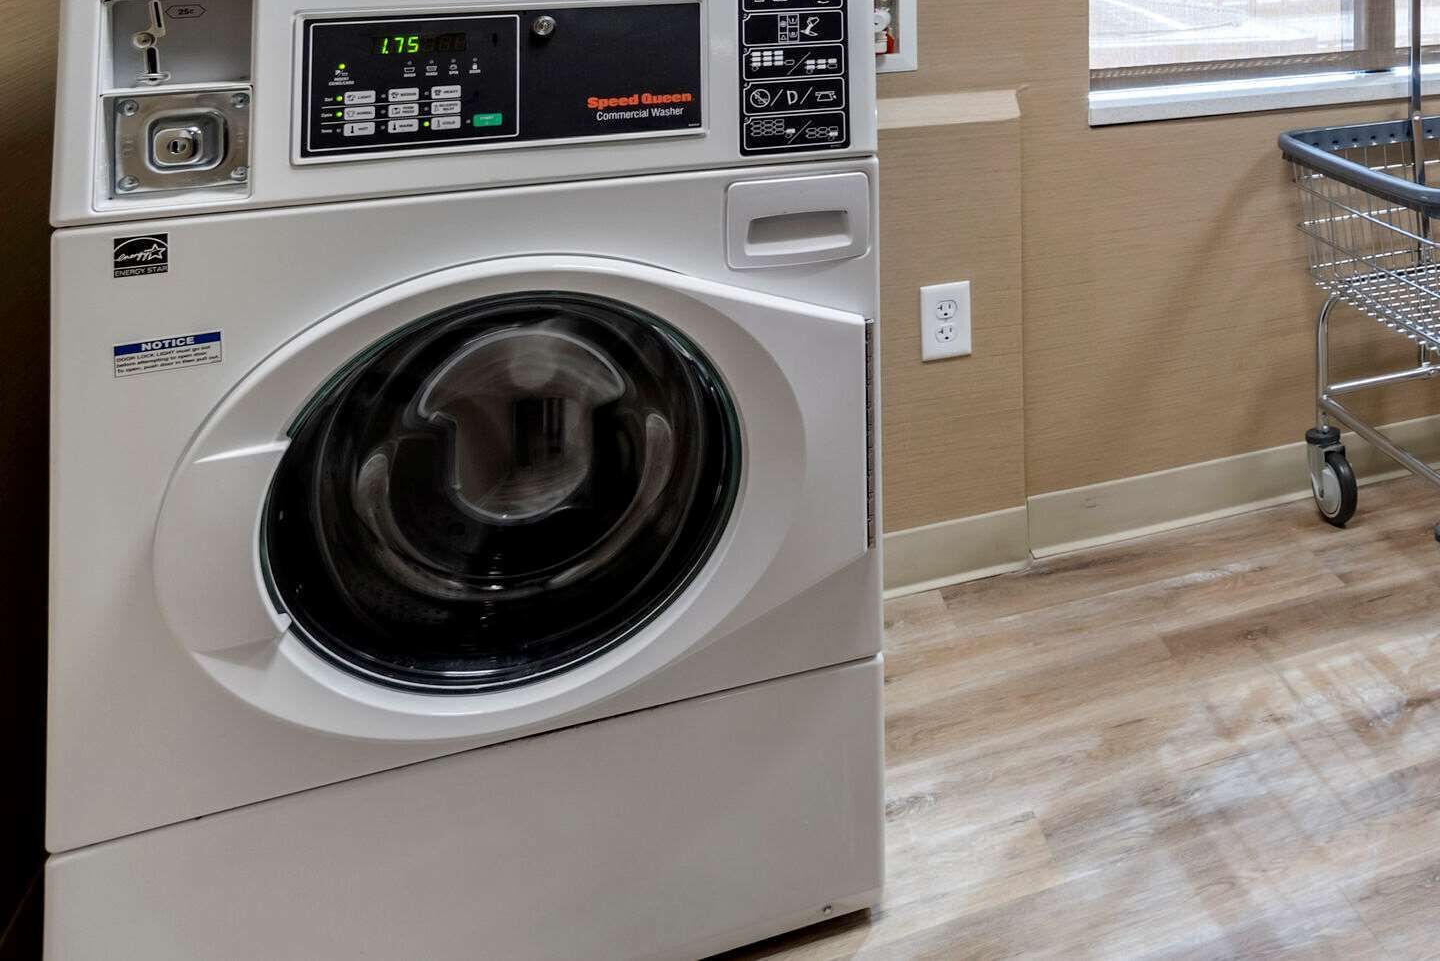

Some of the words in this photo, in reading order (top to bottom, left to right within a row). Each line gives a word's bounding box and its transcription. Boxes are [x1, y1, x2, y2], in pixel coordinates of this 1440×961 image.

[381, 36, 419, 54] 1.75
[587, 94, 639, 110] Speed
[641, 93, 692, 105] Queen
[596, 109, 649, 121] Commercial
[651, 107, 684, 117] Washer
[115, 268, 146, 277] ENERGY
[141, 337, 195, 351] NOTICE
